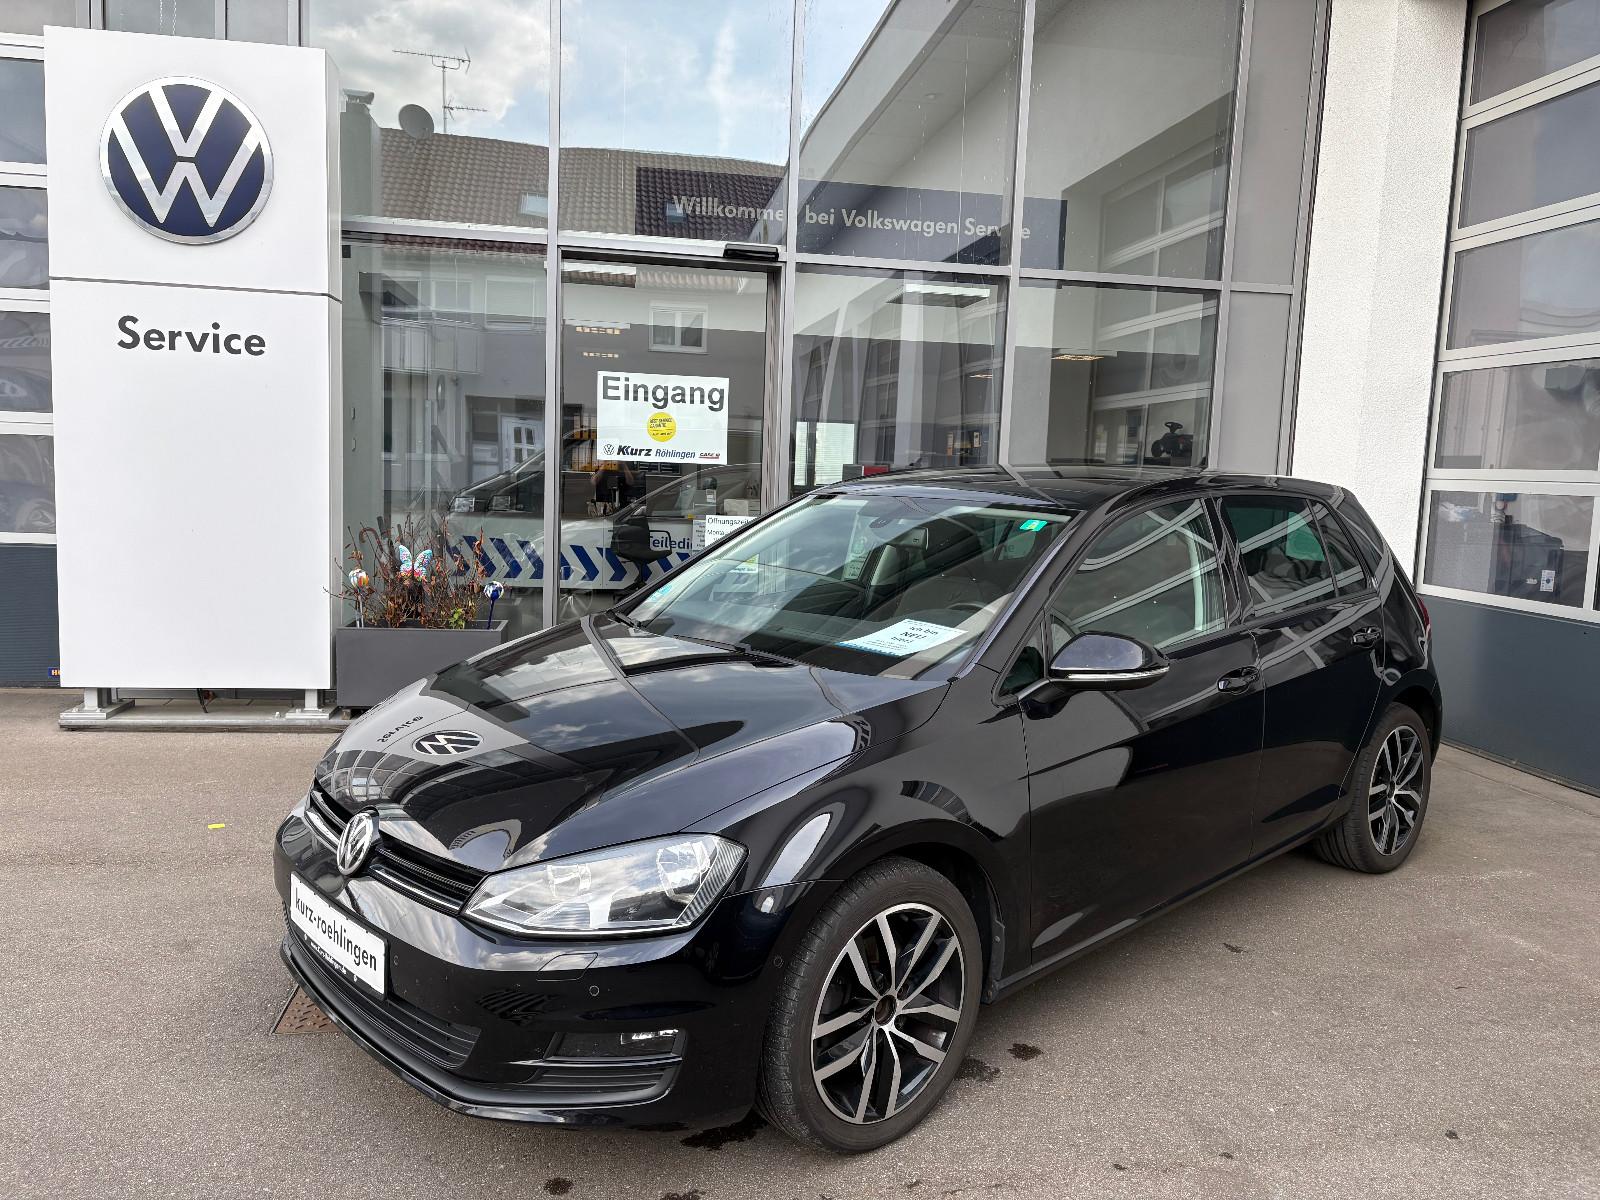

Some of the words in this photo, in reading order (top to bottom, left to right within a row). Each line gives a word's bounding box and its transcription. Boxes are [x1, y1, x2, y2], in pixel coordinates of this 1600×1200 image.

[672, 195, 784, 222] Willkomme
[805, 204, 835, 226] bei
[842, 208, 958, 238] Volkswagen
[964, 217, 1031, 239] Serve
[117, 315, 267, 357] Service
[602, 375, 725, 412] Eingang
[655, 448, 696, 460] Röhlingen
[650, 535, 692, 550] eiledi
[295, 886, 378, 973] kurz-roehlingen
